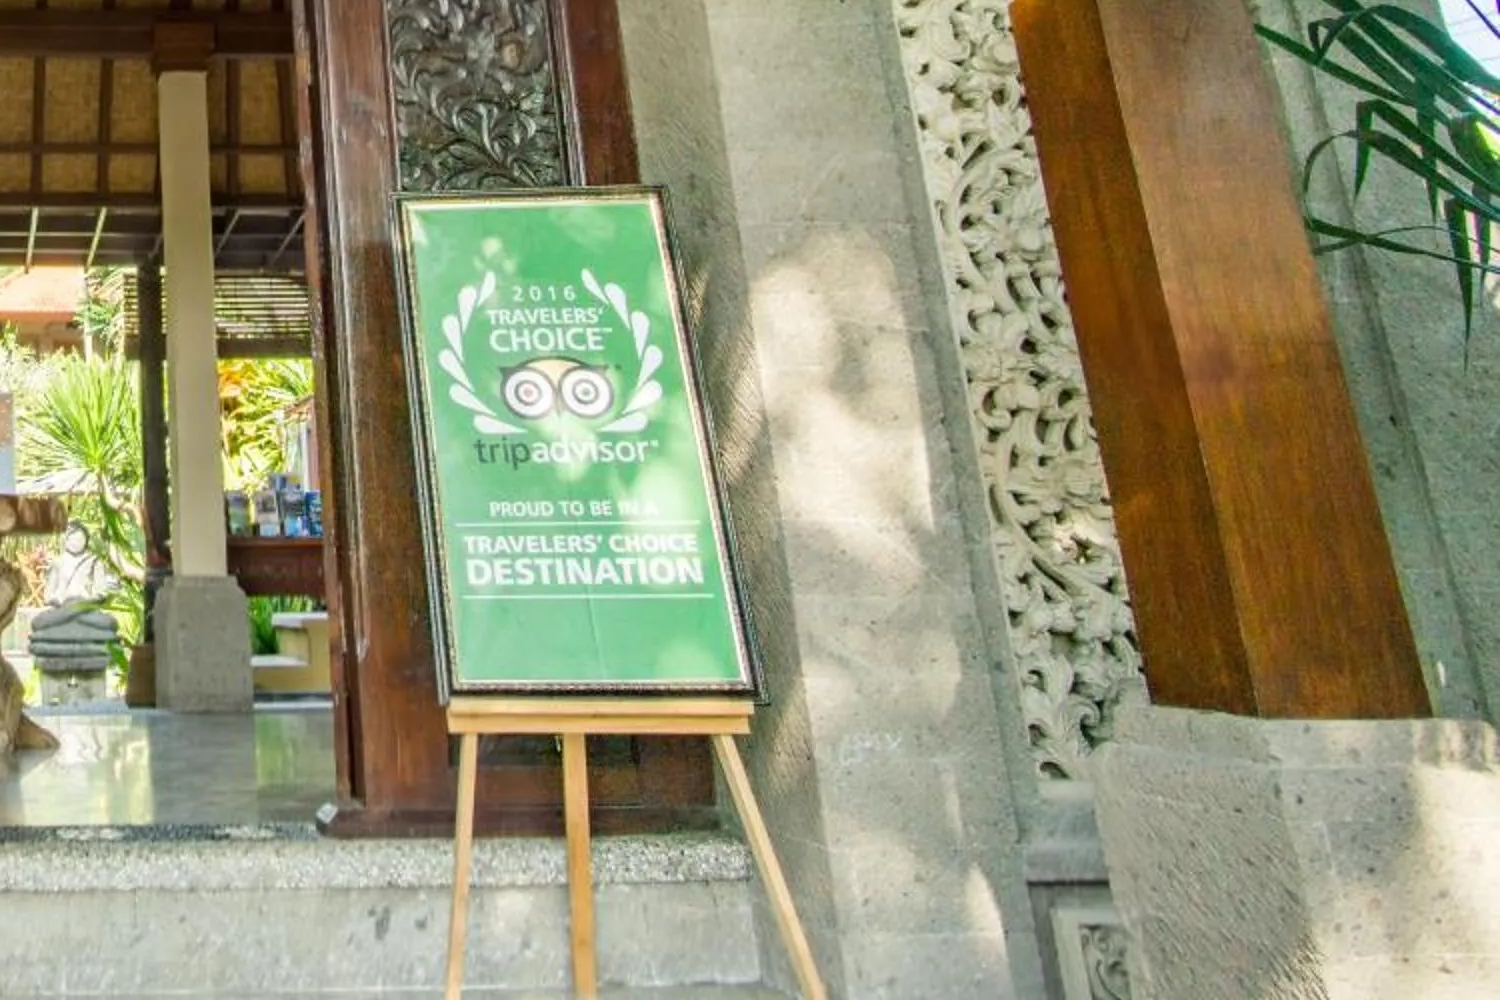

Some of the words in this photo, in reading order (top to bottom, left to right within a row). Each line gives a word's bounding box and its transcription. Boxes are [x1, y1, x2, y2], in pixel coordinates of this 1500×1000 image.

[512, 285, 576, 301] 2016
[489, 501, 554, 518] PROUD
[559, 501, 584, 517] TO
[589, 501, 612, 516] BE
[608, 533, 697, 553] CHOICE
[467, 557, 704, 585] DESTINATION
